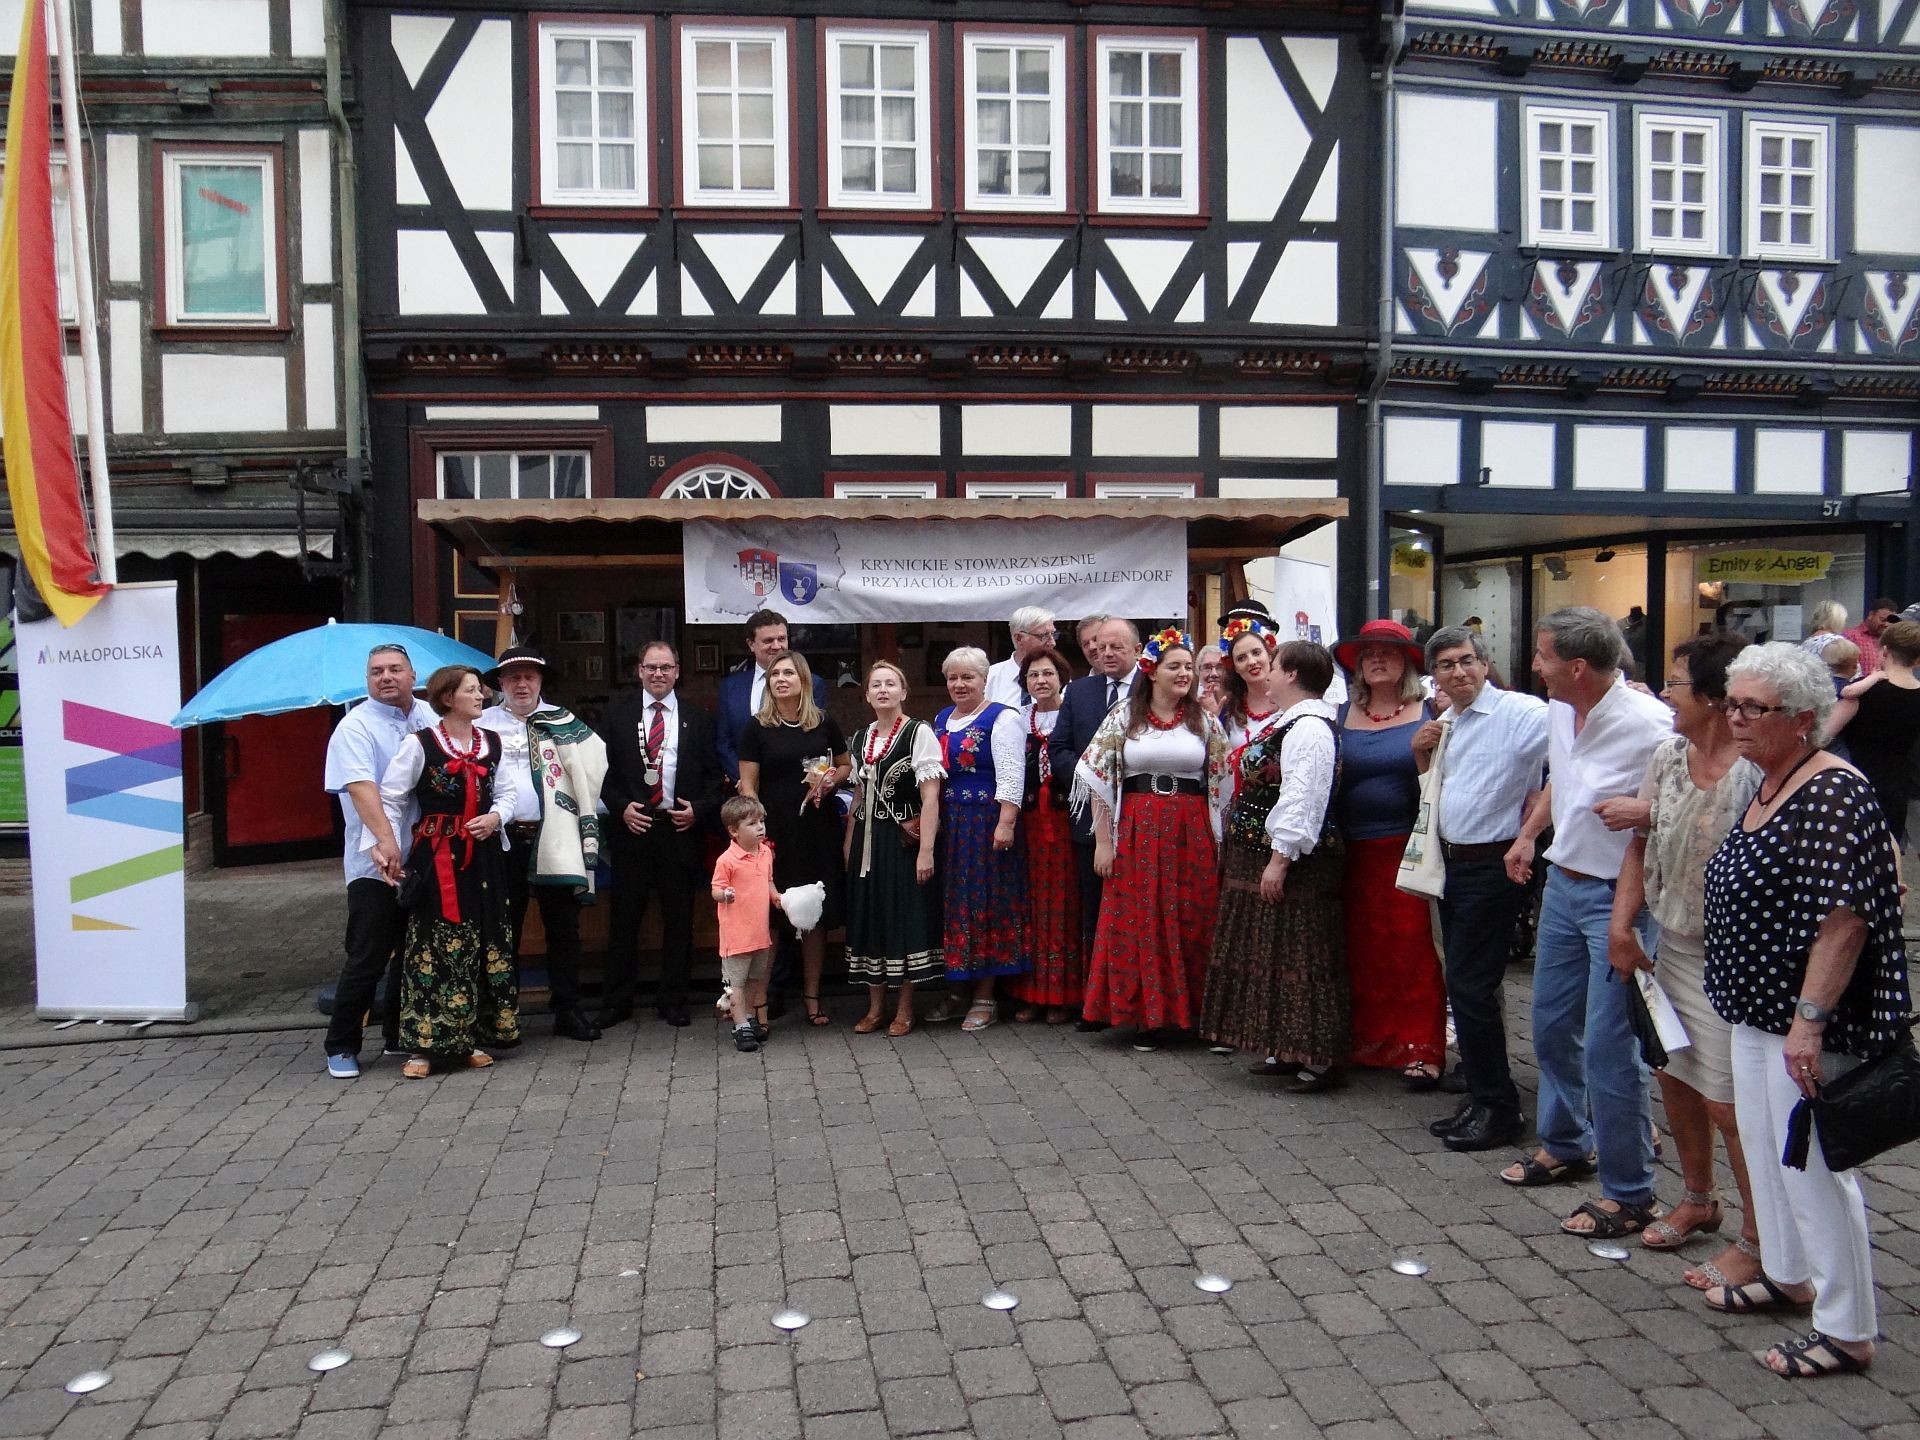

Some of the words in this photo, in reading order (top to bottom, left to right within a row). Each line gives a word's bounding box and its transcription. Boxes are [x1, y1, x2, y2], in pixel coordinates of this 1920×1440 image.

[649, 455, 665, 468] 55
[1822, 500, 1842, 517] 57
[860, 558, 949, 571] KRYNICKIE
[954, 553, 1096, 571] STOWARZYSZENIE
[1708, 557, 1750, 573] Emily
[1769, 555, 1820, 572] Angel
[862, 574, 959, 589] PRZYJACIÓŁ
[962, 576, 973, 588] Z
[977, 575, 1011, 588] BAD
[1015, 569, 1174, 586] SOODEN-ALLENDORF
[58, 644, 164, 663] MAŁOPOLSKA
